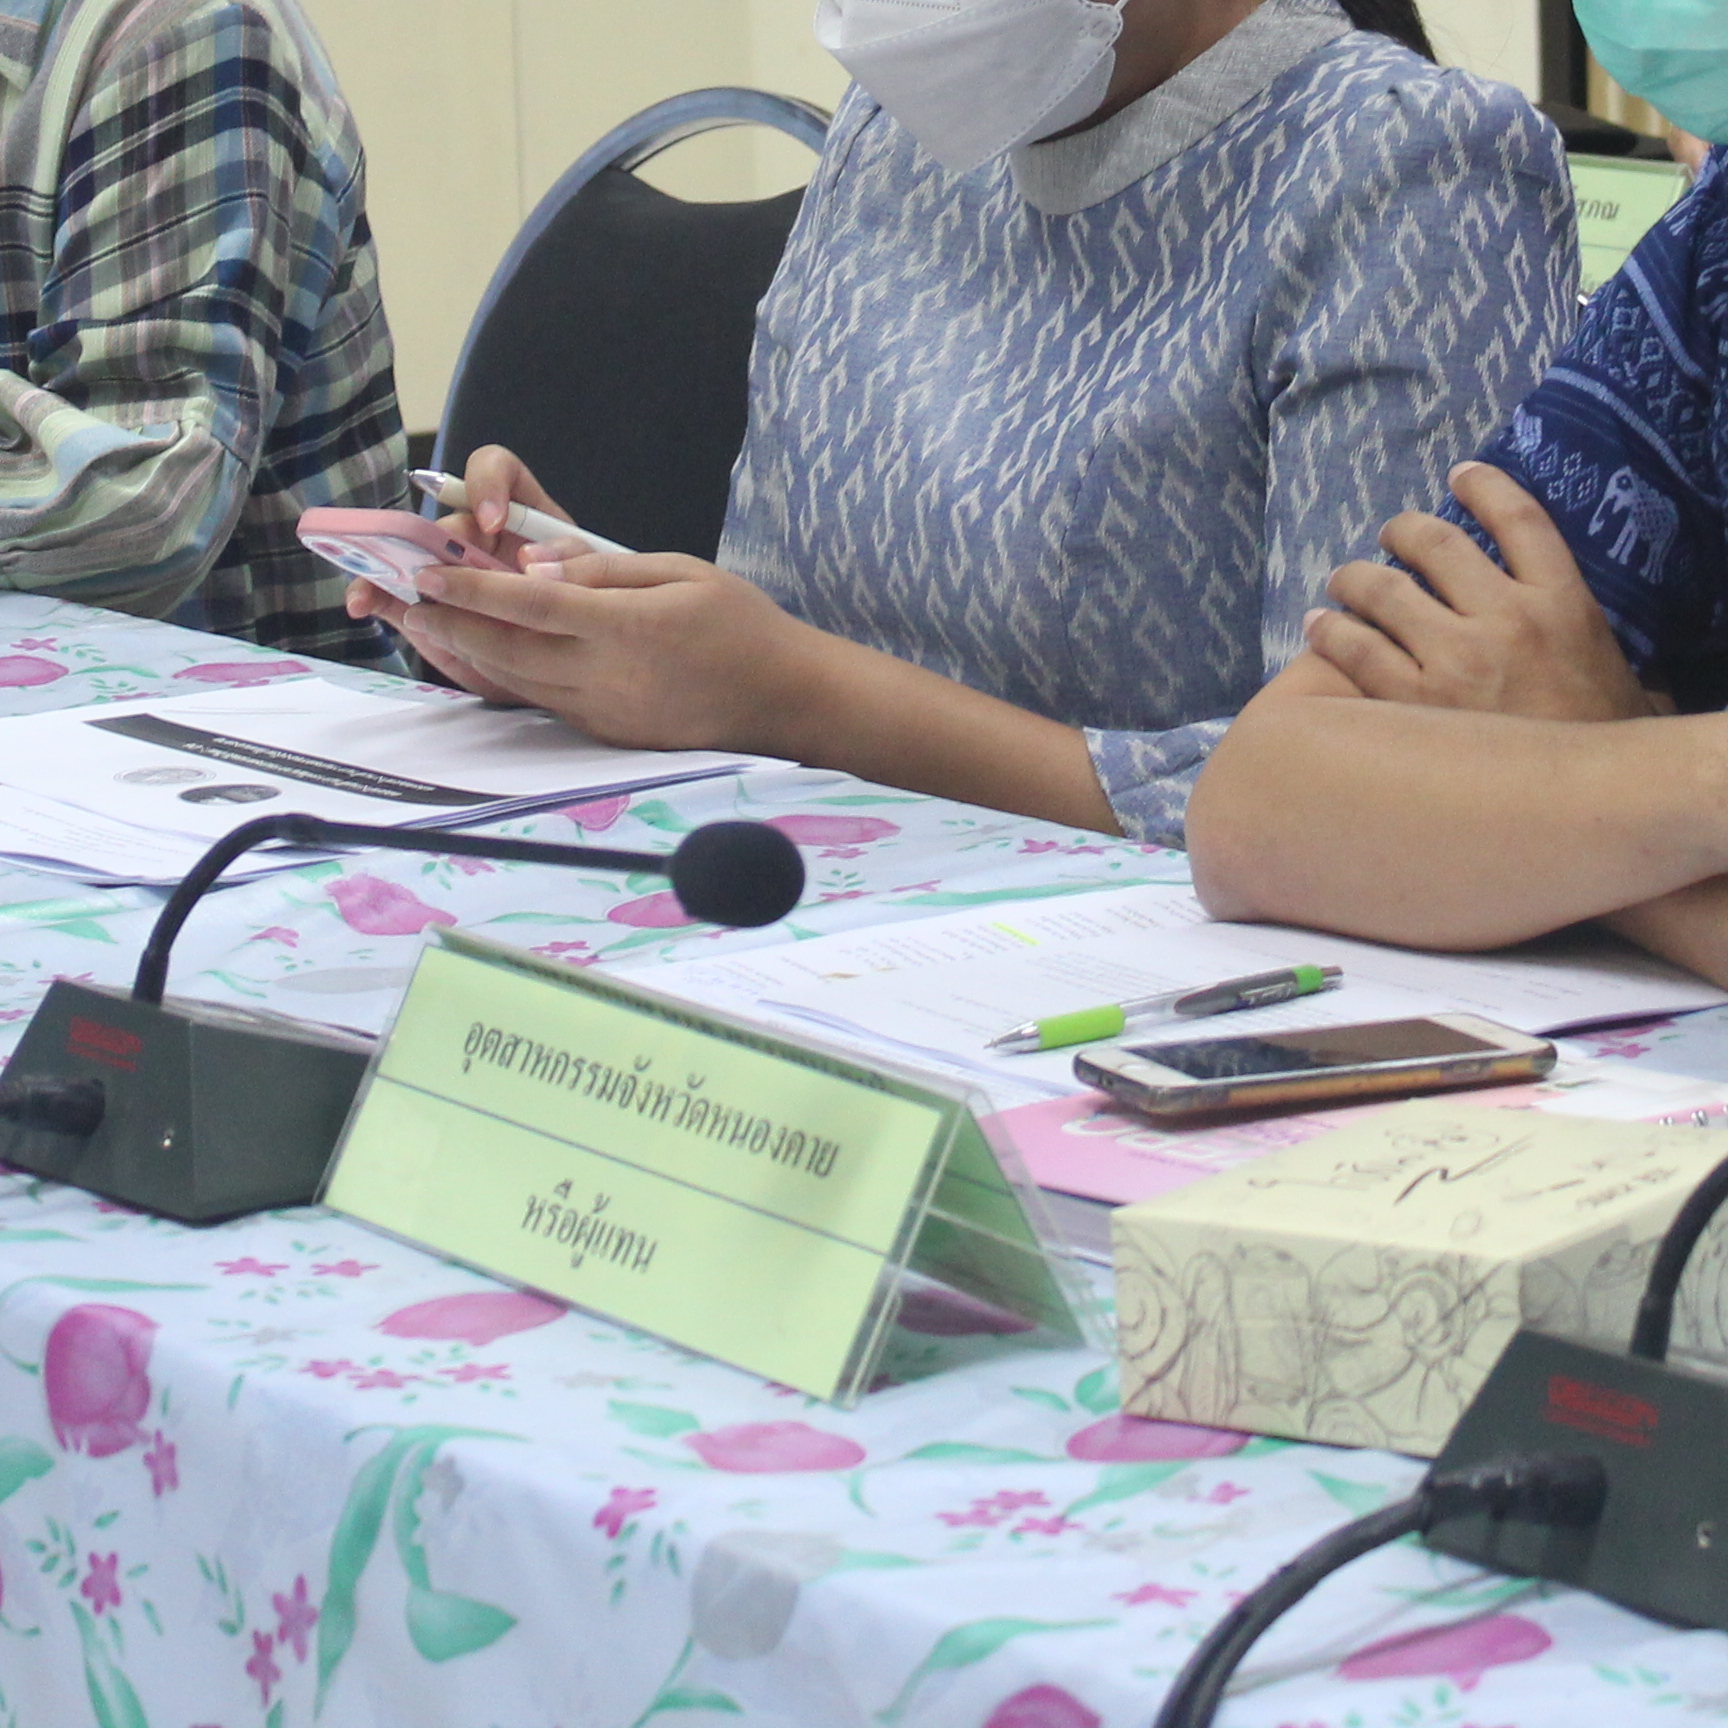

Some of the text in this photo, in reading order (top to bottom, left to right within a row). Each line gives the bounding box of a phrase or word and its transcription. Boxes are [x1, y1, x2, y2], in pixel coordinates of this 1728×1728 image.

[463, 1021, 840, 1177] อุตสาหกรรมจังหวัดหนองคาย
[521, 1179, 659, 1274] หรือผู้แทน
